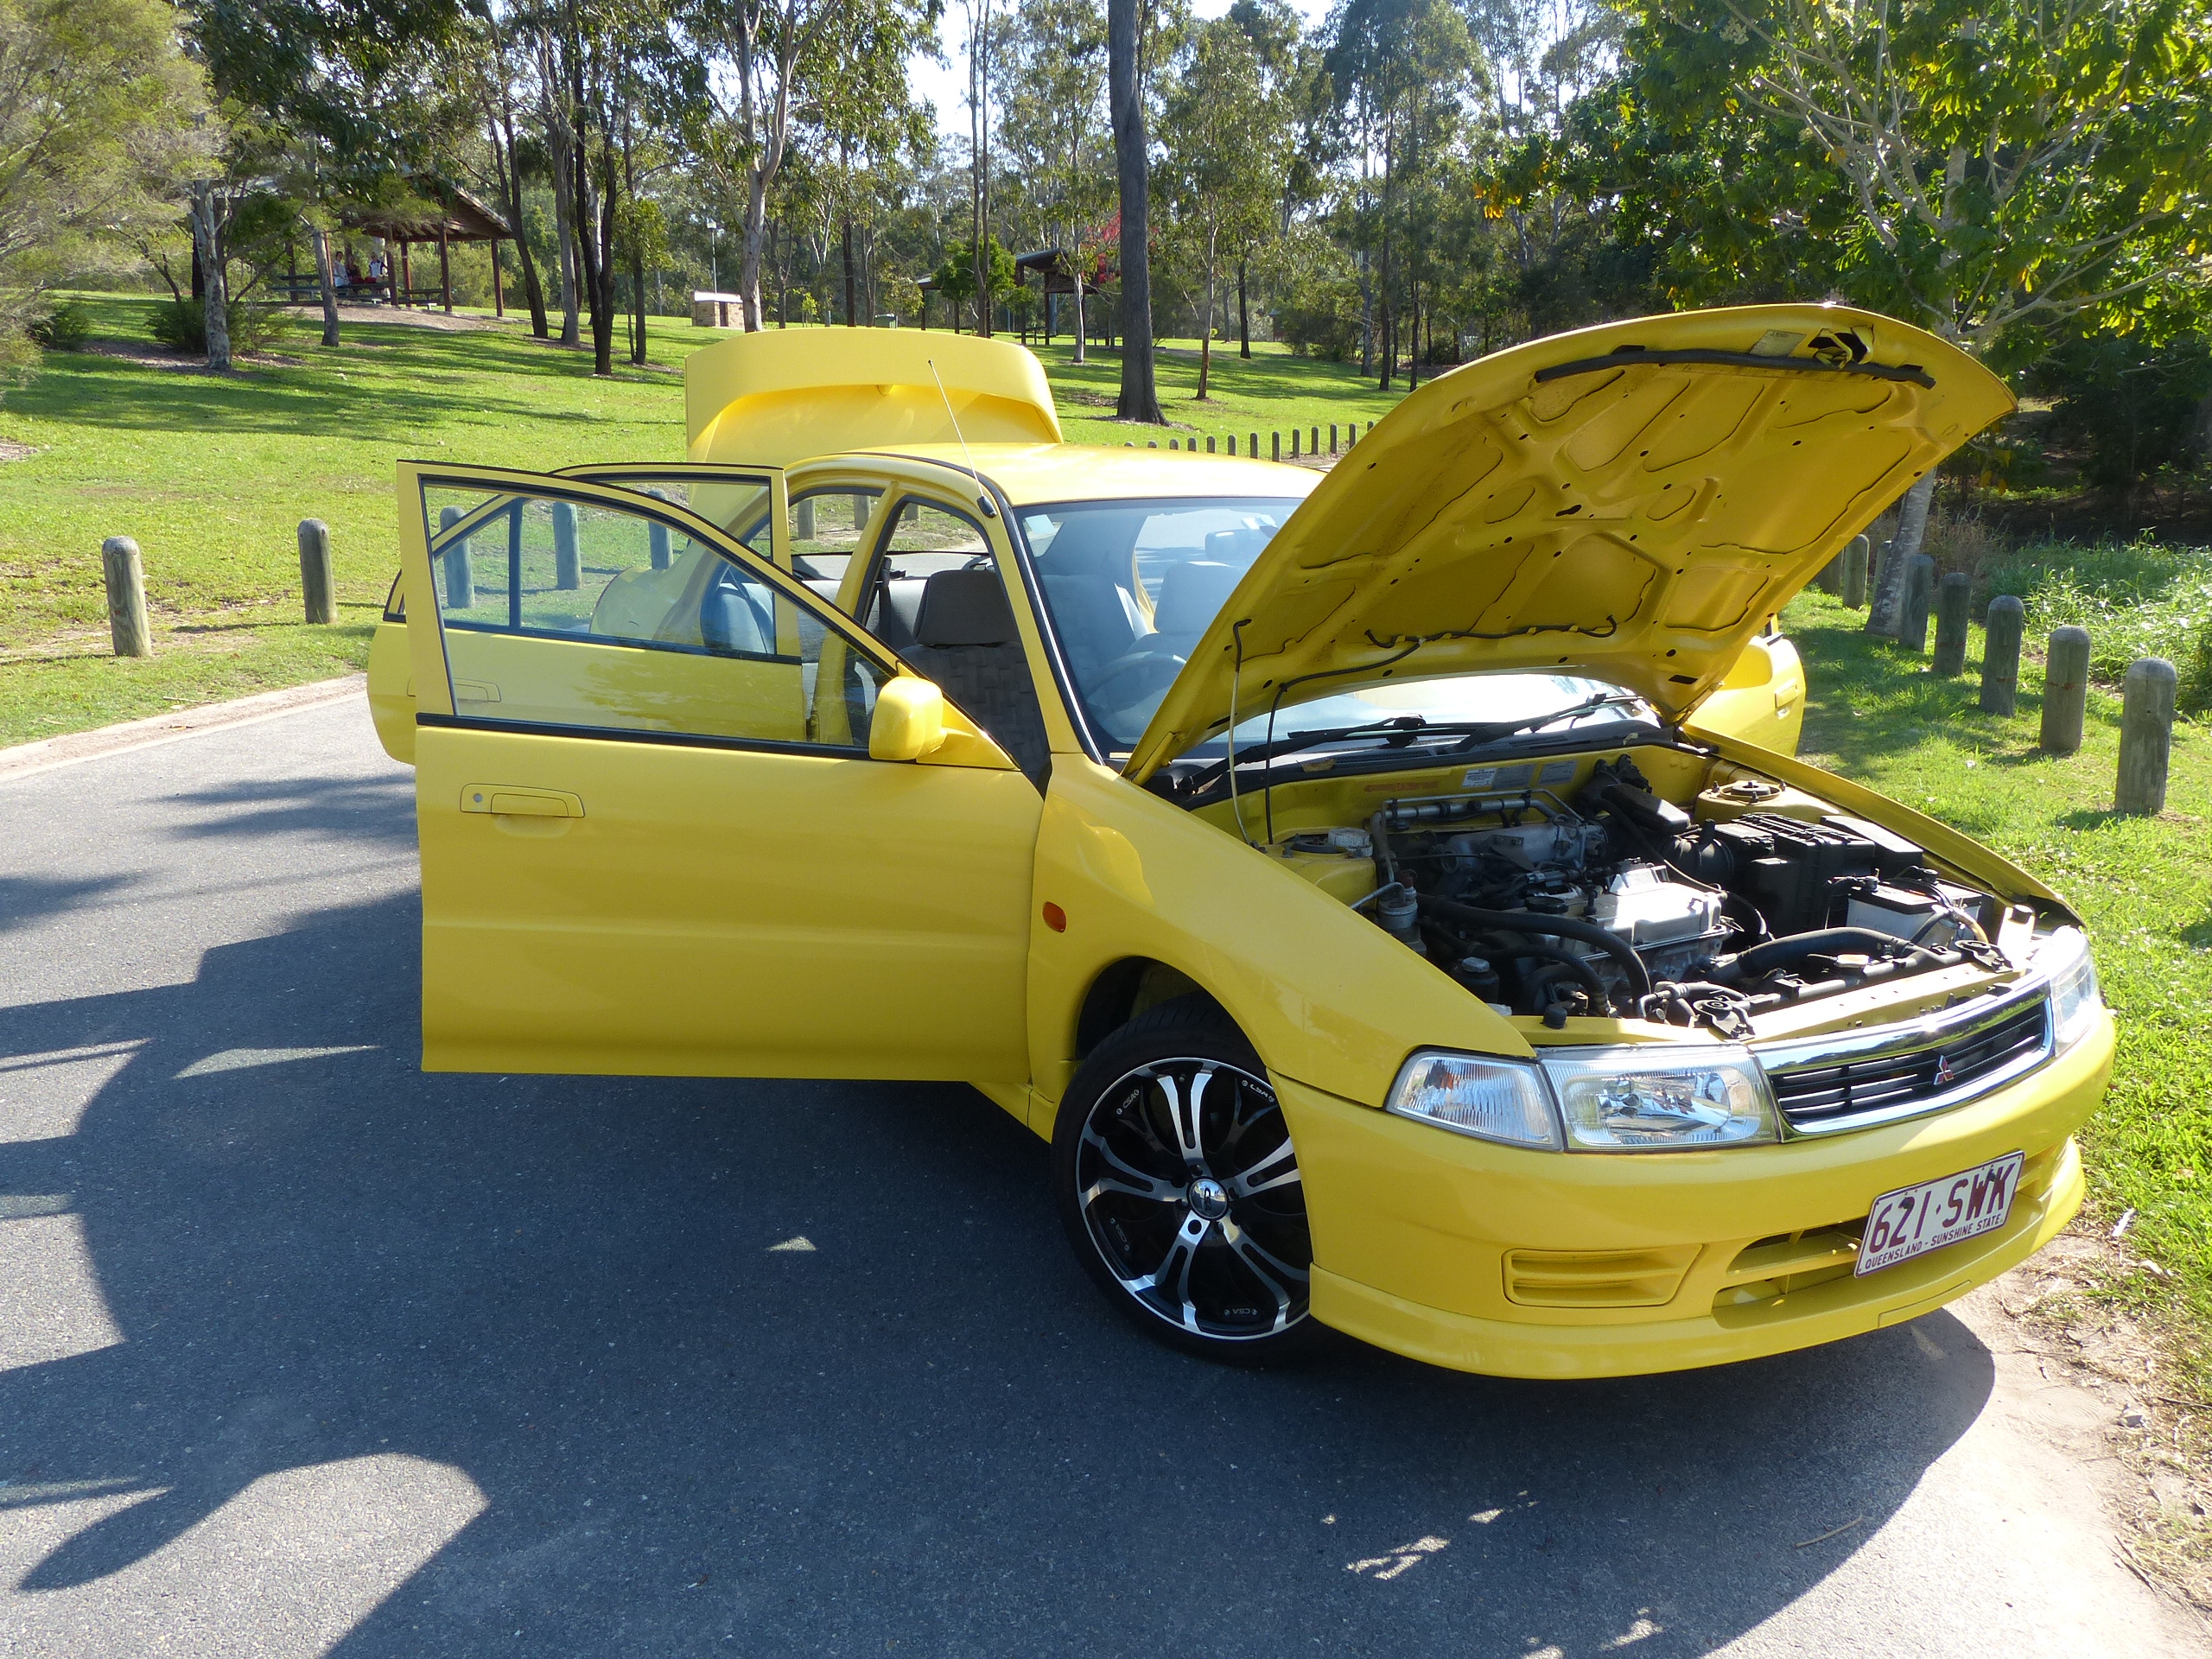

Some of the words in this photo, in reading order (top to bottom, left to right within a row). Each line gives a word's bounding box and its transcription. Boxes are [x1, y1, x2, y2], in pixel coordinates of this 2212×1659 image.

[1123, 1093, 1136, 1109] CSA
[1865, 1241, 1922, 1269] QUEENSLAND
[1930, 1224, 1973, 1246] SUNSHINE
[1976, 1213, 2000, 1231] STATE
